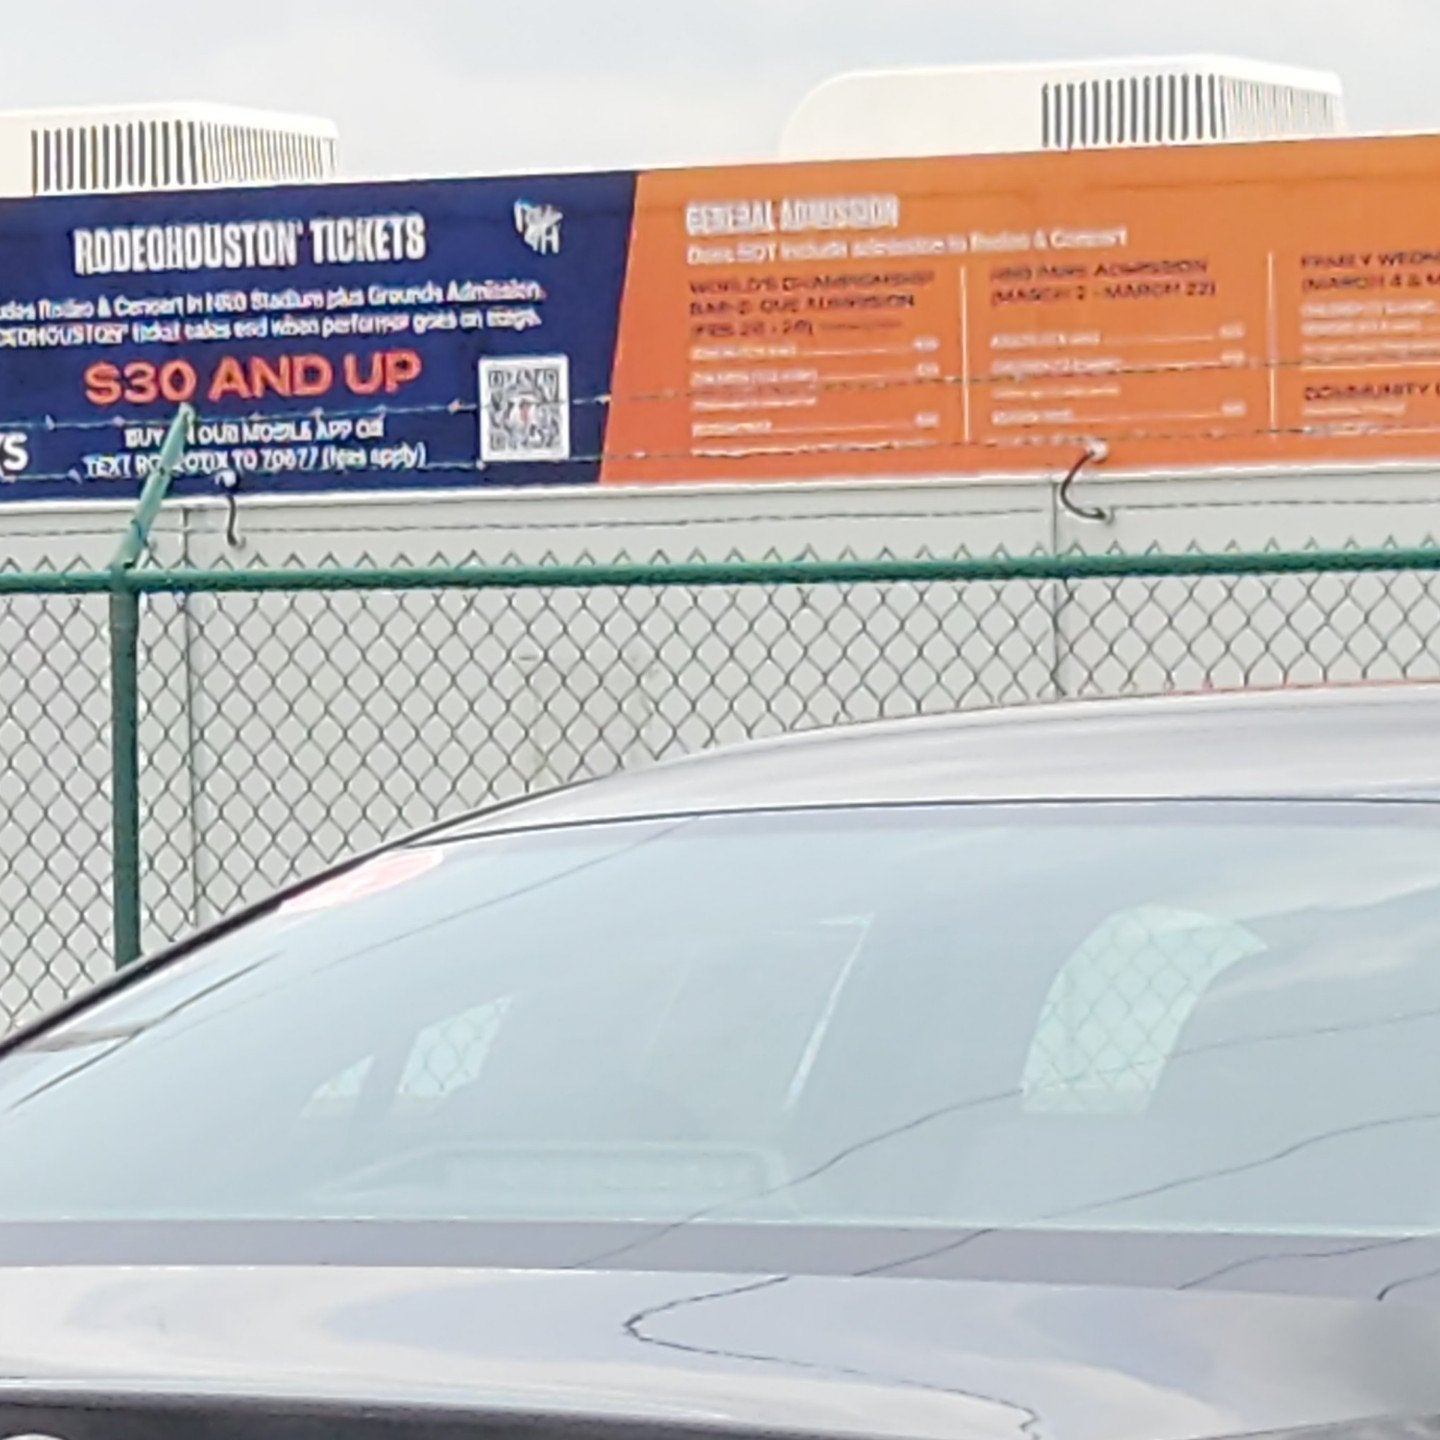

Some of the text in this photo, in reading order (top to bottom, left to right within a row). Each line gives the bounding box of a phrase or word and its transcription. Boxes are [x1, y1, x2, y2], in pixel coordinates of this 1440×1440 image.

[310, 214, 426, 264] TICKETS
[208, 352, 333, 402] AND
[344, 350, 422, 394] UP
[124, 424, 165, 449] BUY
[135, 450, 228, 480] ROOTIX
[232, 448, 257, 473] TO
